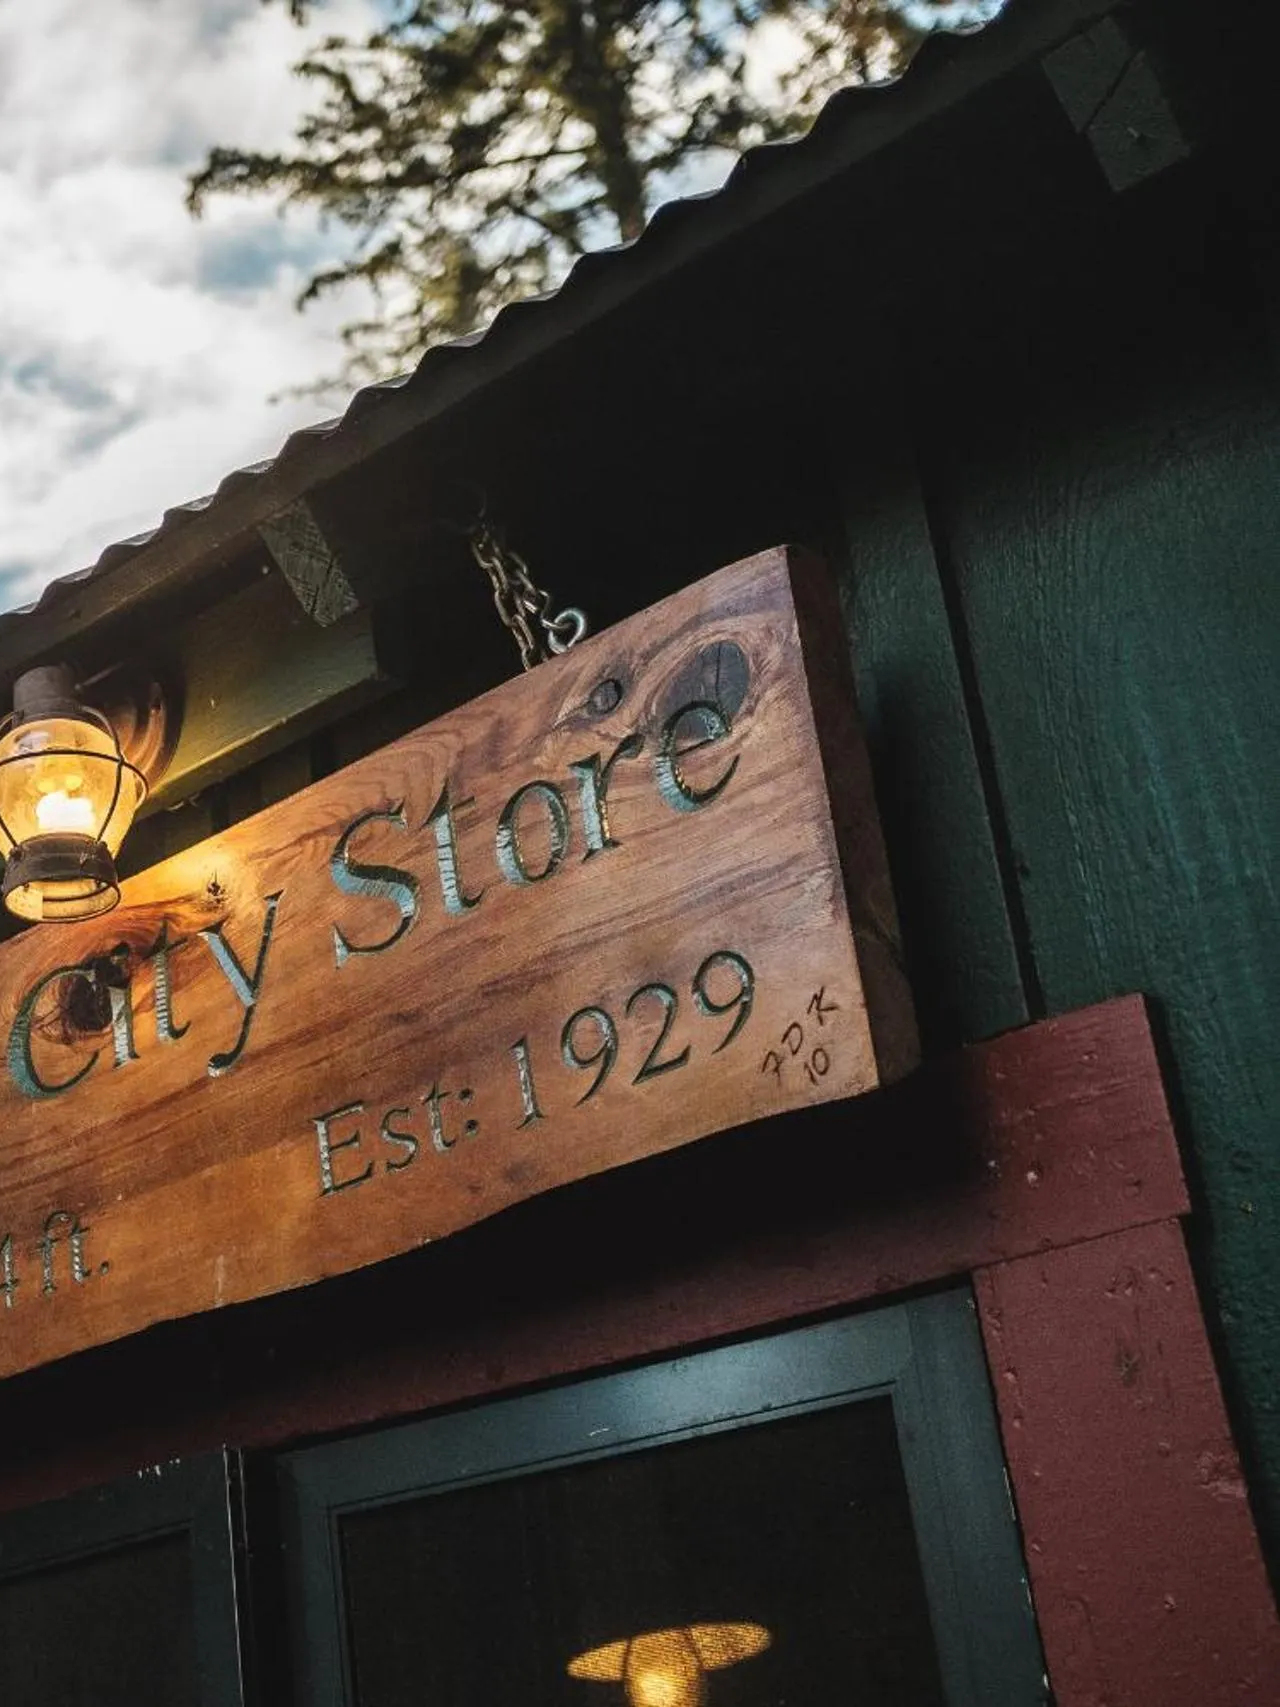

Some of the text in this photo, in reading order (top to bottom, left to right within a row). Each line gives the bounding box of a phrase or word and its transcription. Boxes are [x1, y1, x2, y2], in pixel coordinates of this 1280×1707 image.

[7, 888, 284, 1098] City
[329, 700, 741, 970] Store
[311, 949, 756, 1198] Est: 1929
[37, 1209, 111, 1296] ft.
